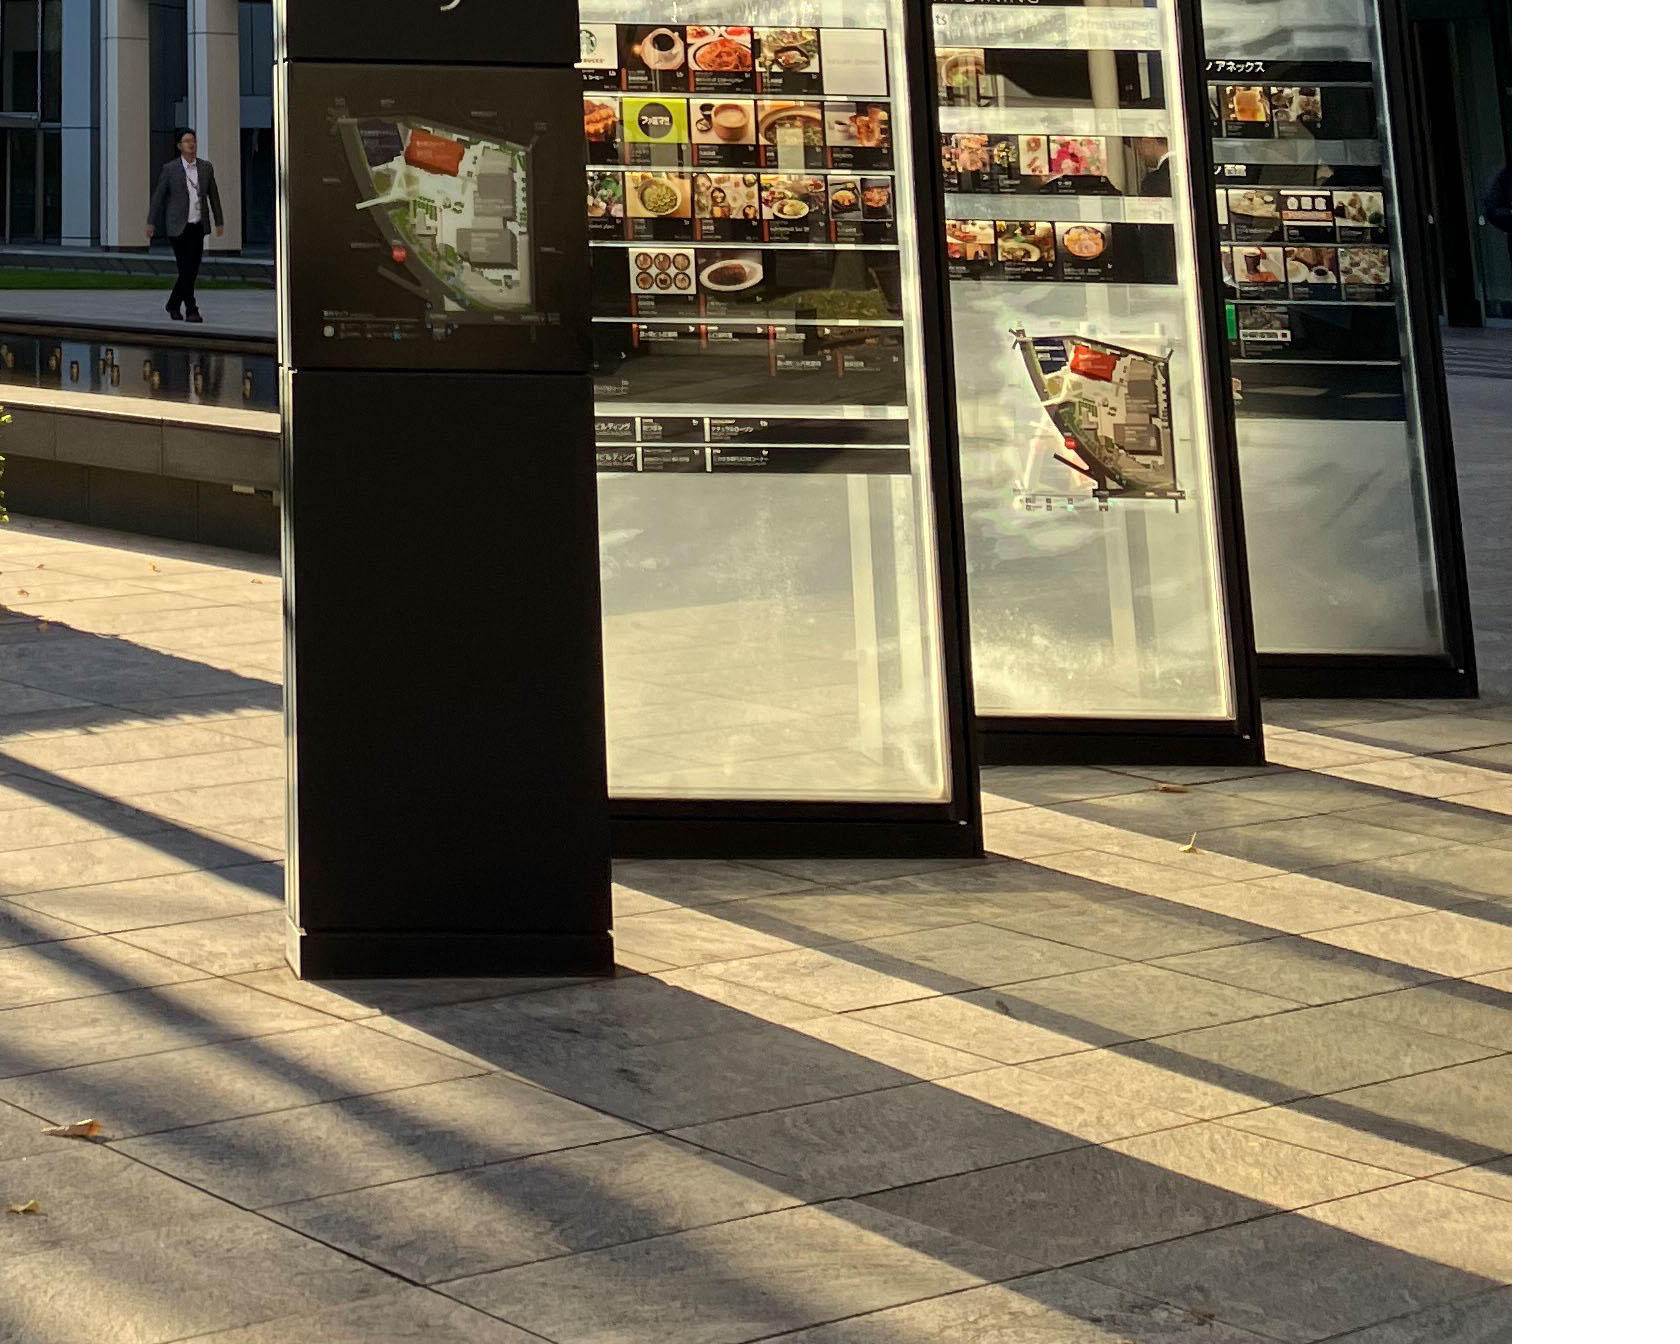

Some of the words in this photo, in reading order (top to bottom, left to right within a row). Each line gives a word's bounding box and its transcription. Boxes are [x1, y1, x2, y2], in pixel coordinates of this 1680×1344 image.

[1216, 61, 1265, 73] アネックス
